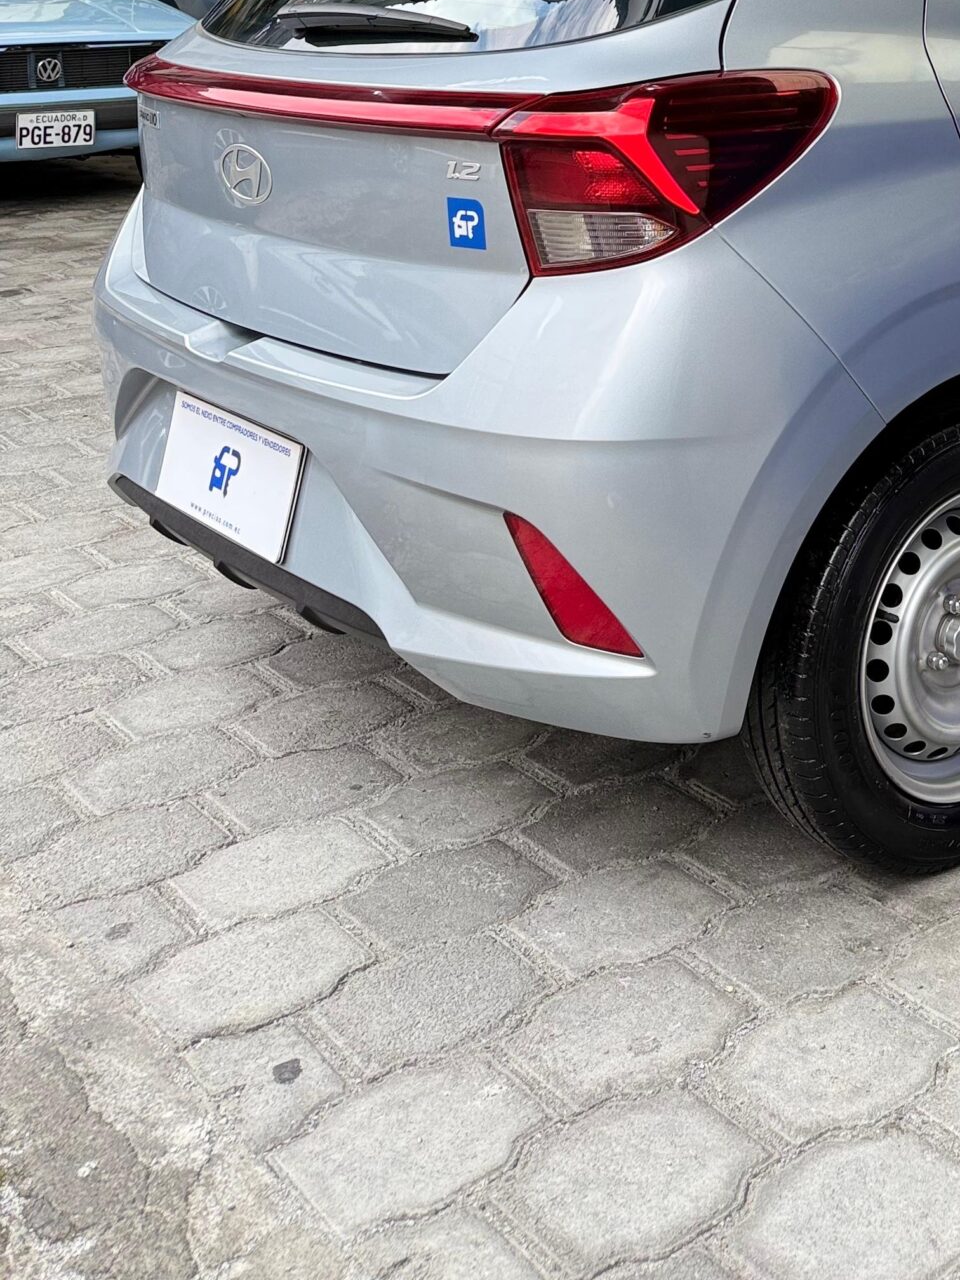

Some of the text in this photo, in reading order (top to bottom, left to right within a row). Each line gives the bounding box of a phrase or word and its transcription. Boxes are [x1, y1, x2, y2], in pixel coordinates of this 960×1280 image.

[35, 114, 77, 124] ECUADOR
[18, 123, 94, 147] PGE-879
[446, 160, 481, 181] 1.2
